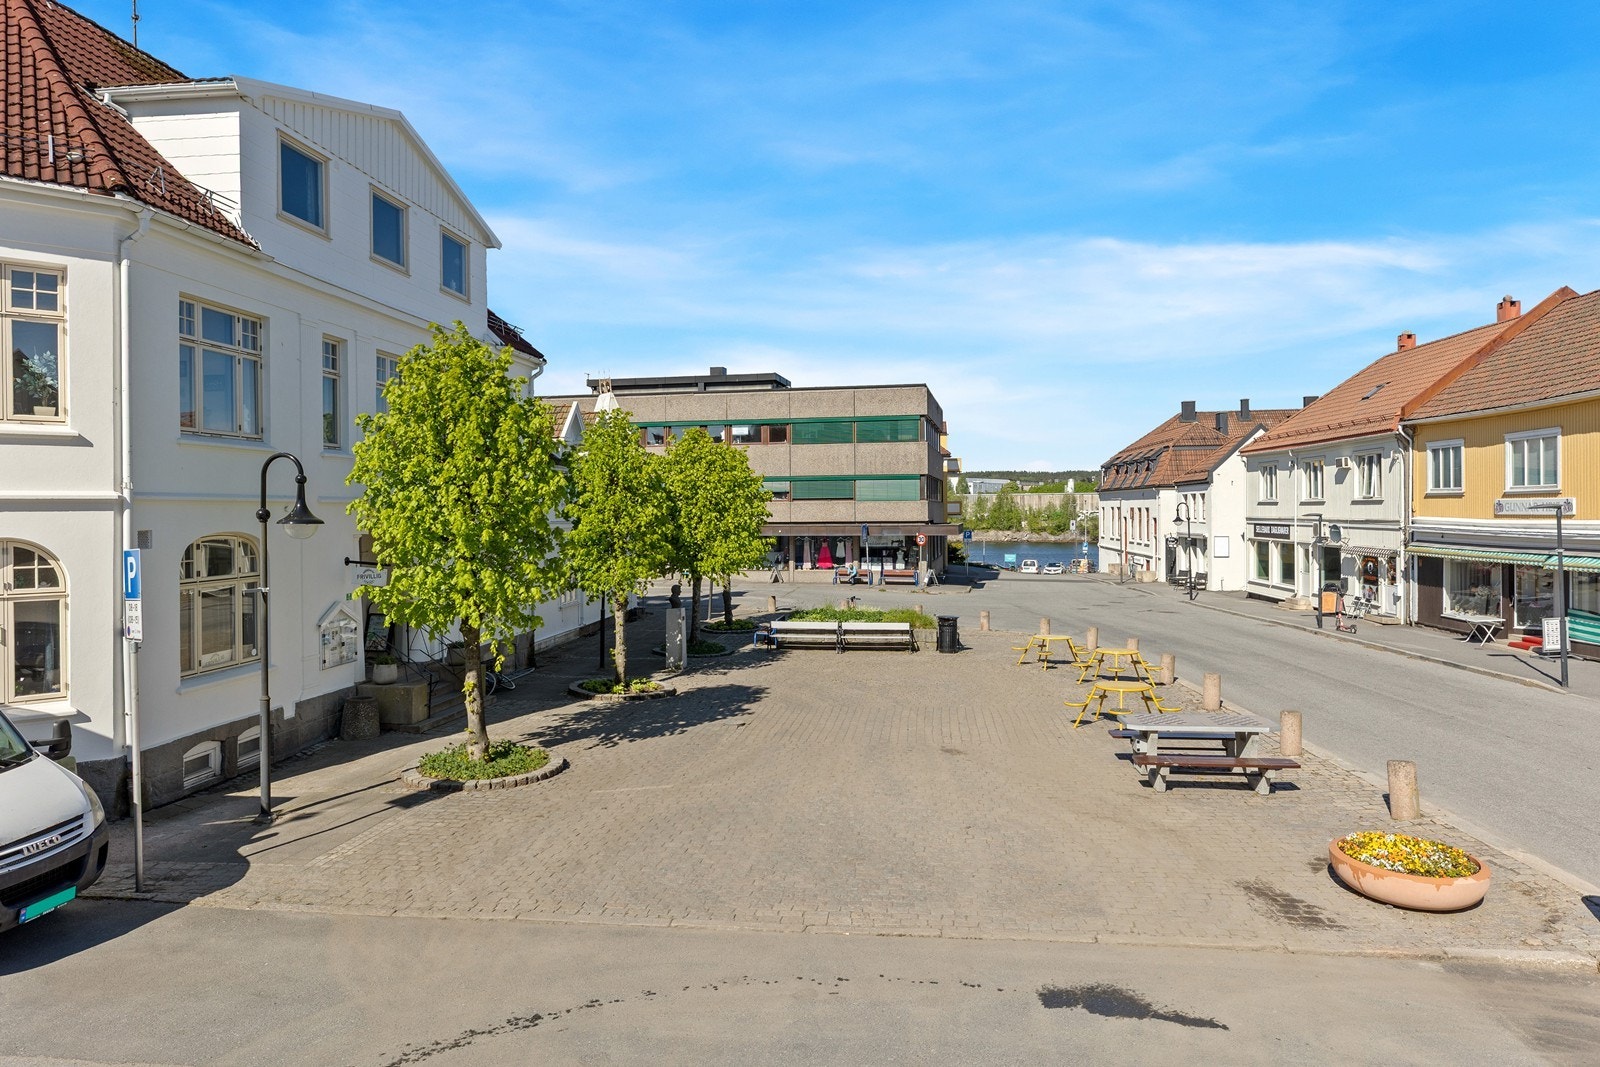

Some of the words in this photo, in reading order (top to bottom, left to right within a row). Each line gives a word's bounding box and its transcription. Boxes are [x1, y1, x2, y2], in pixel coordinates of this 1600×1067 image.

[1504, 502, 1539, 512] GUNNAR
[127, 556, 136, 593] P
[22, 834, 62, 857] IVECO
